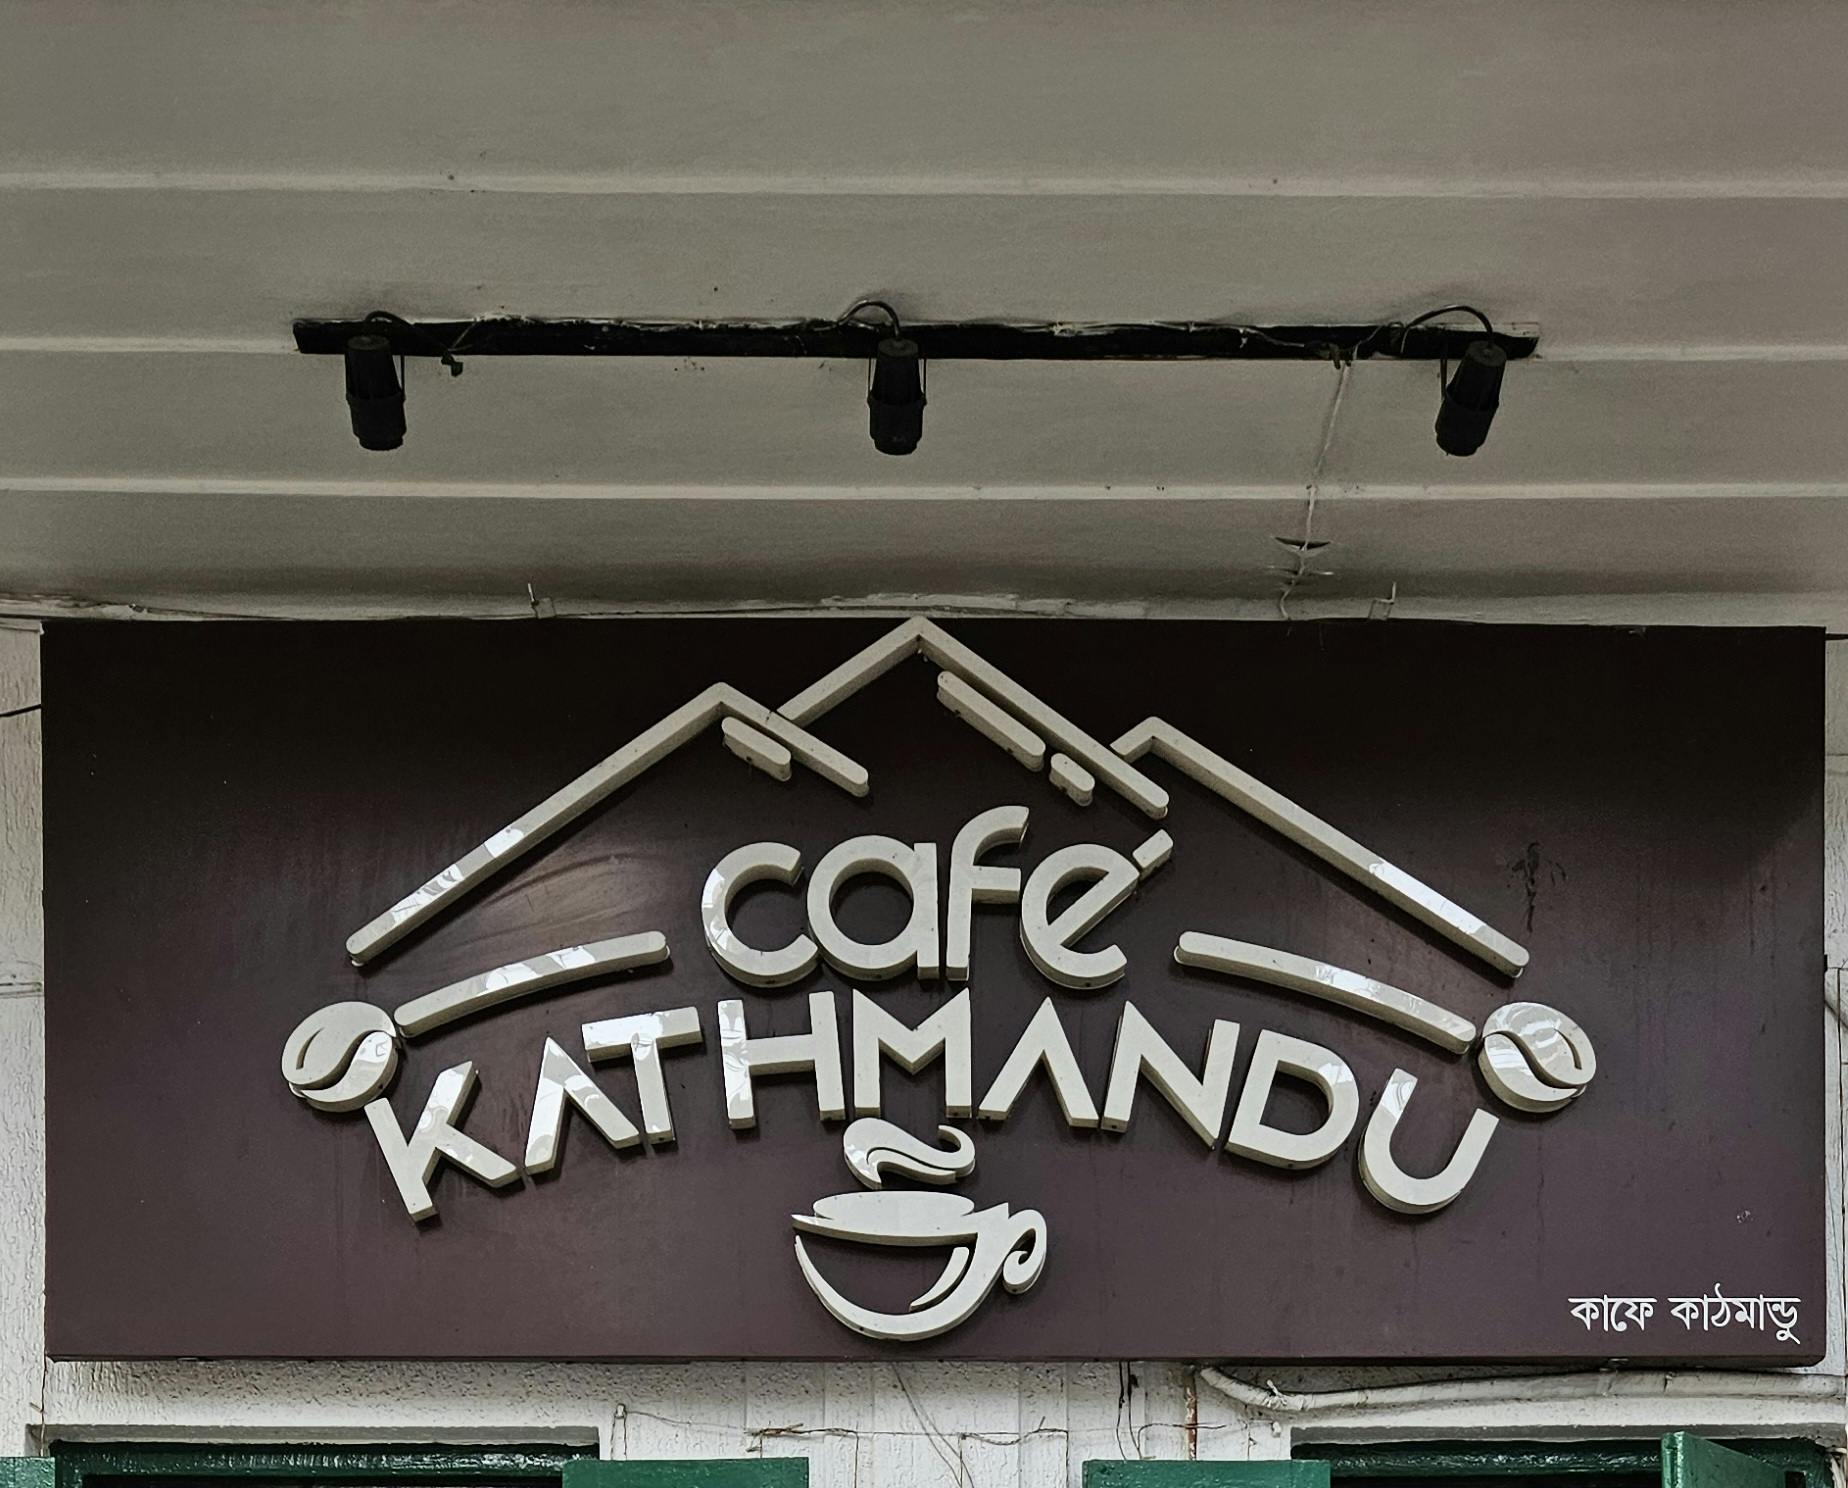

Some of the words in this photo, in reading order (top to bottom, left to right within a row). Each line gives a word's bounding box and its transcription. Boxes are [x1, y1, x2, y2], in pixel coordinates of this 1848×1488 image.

[362, 988, 1500, 1222] KATHMANDU
[1568, 1294, 1657, 1331] কাফে
[1668, 1283, 1801, 1344] কাঠমান্ডু
